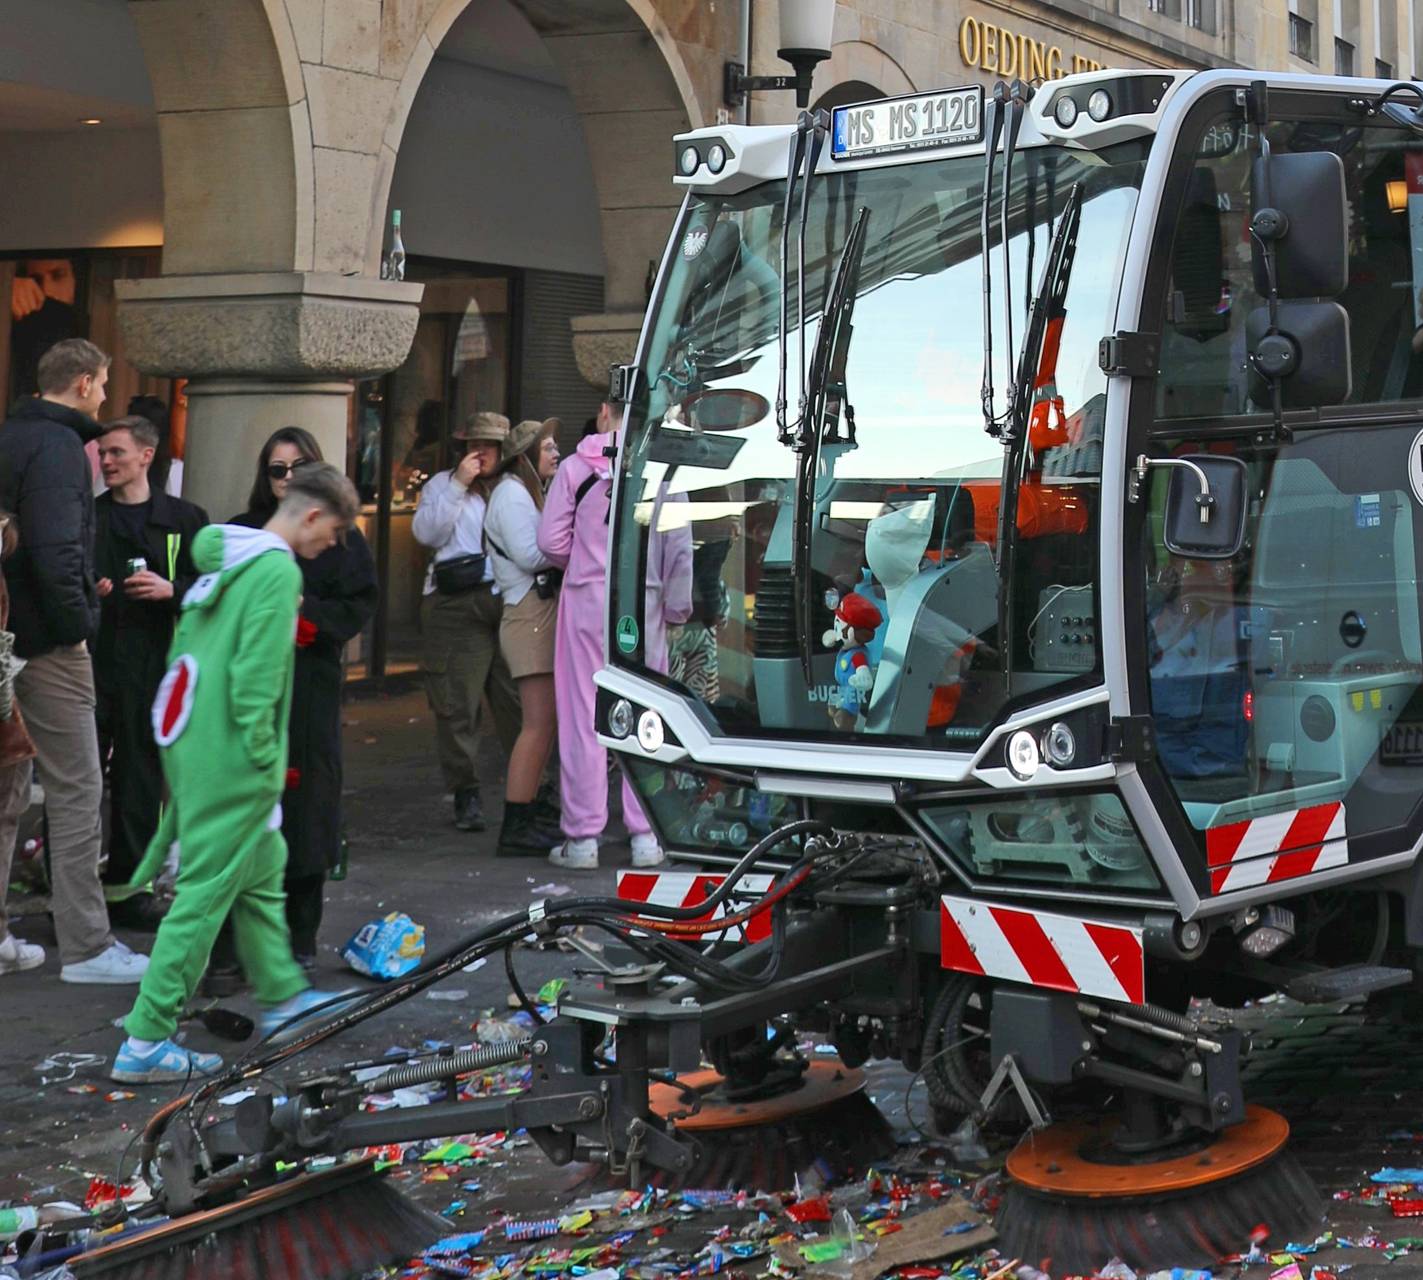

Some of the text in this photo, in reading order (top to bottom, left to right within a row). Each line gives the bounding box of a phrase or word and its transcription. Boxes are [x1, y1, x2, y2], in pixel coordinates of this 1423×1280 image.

[848, 94, 977, 146] MS MS 1120
[838, 135, 844, 146] D
